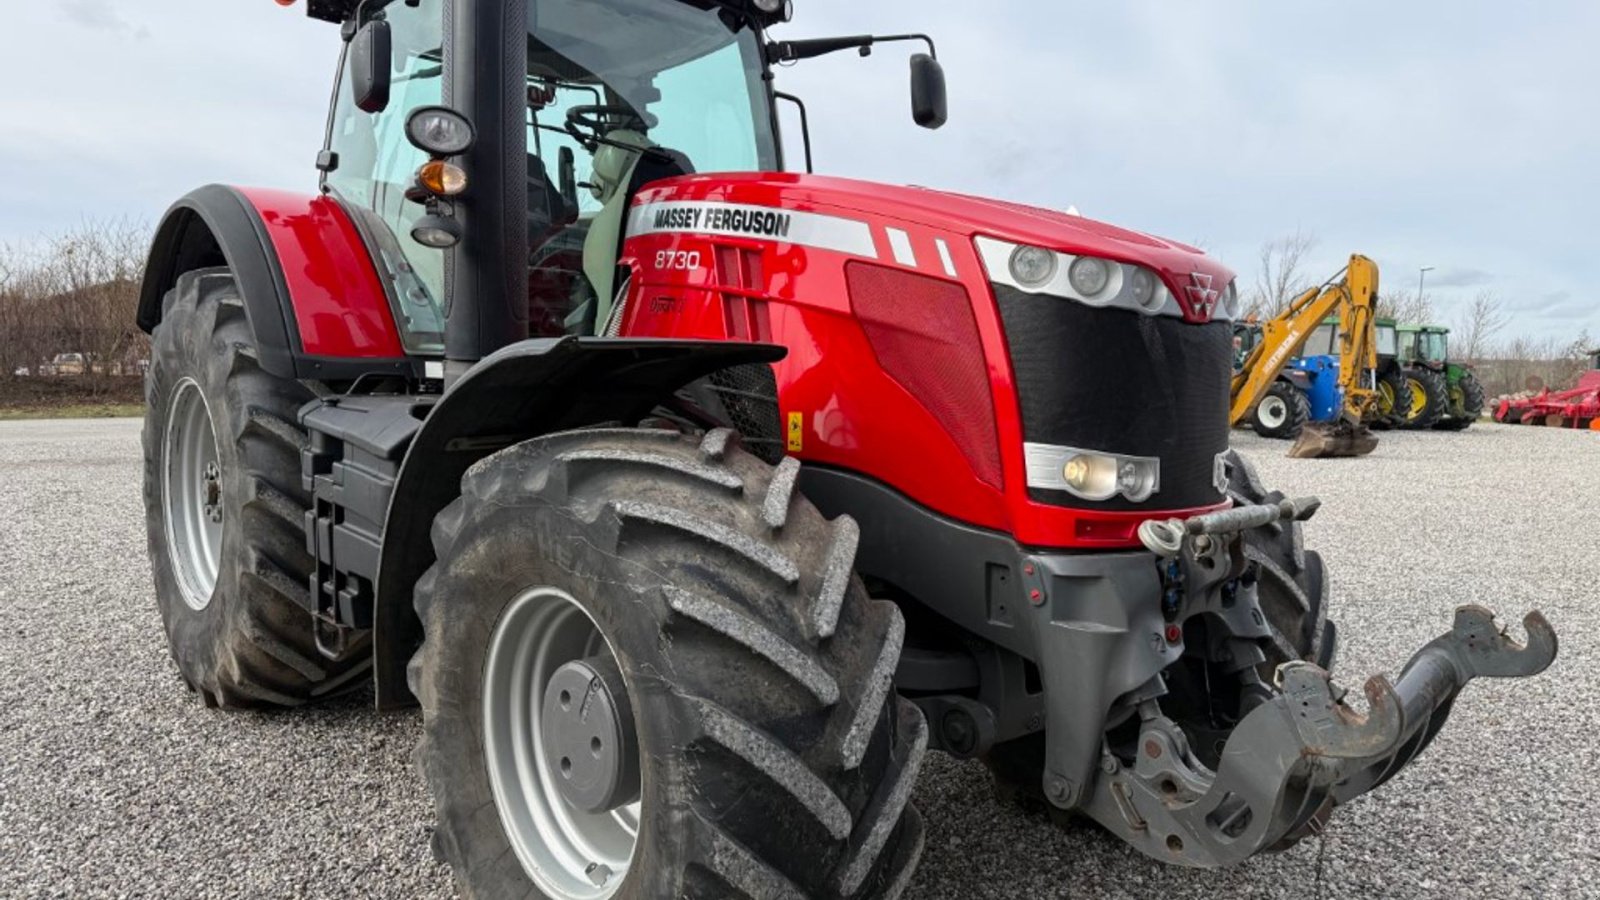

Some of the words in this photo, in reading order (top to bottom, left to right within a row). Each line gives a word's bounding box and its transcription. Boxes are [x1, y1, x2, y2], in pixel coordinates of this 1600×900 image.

[653, 207, 702, 229] MASSEY
[704, 207, 791, 237] FERGUSON
[654, 250, 700, 270] 8730
